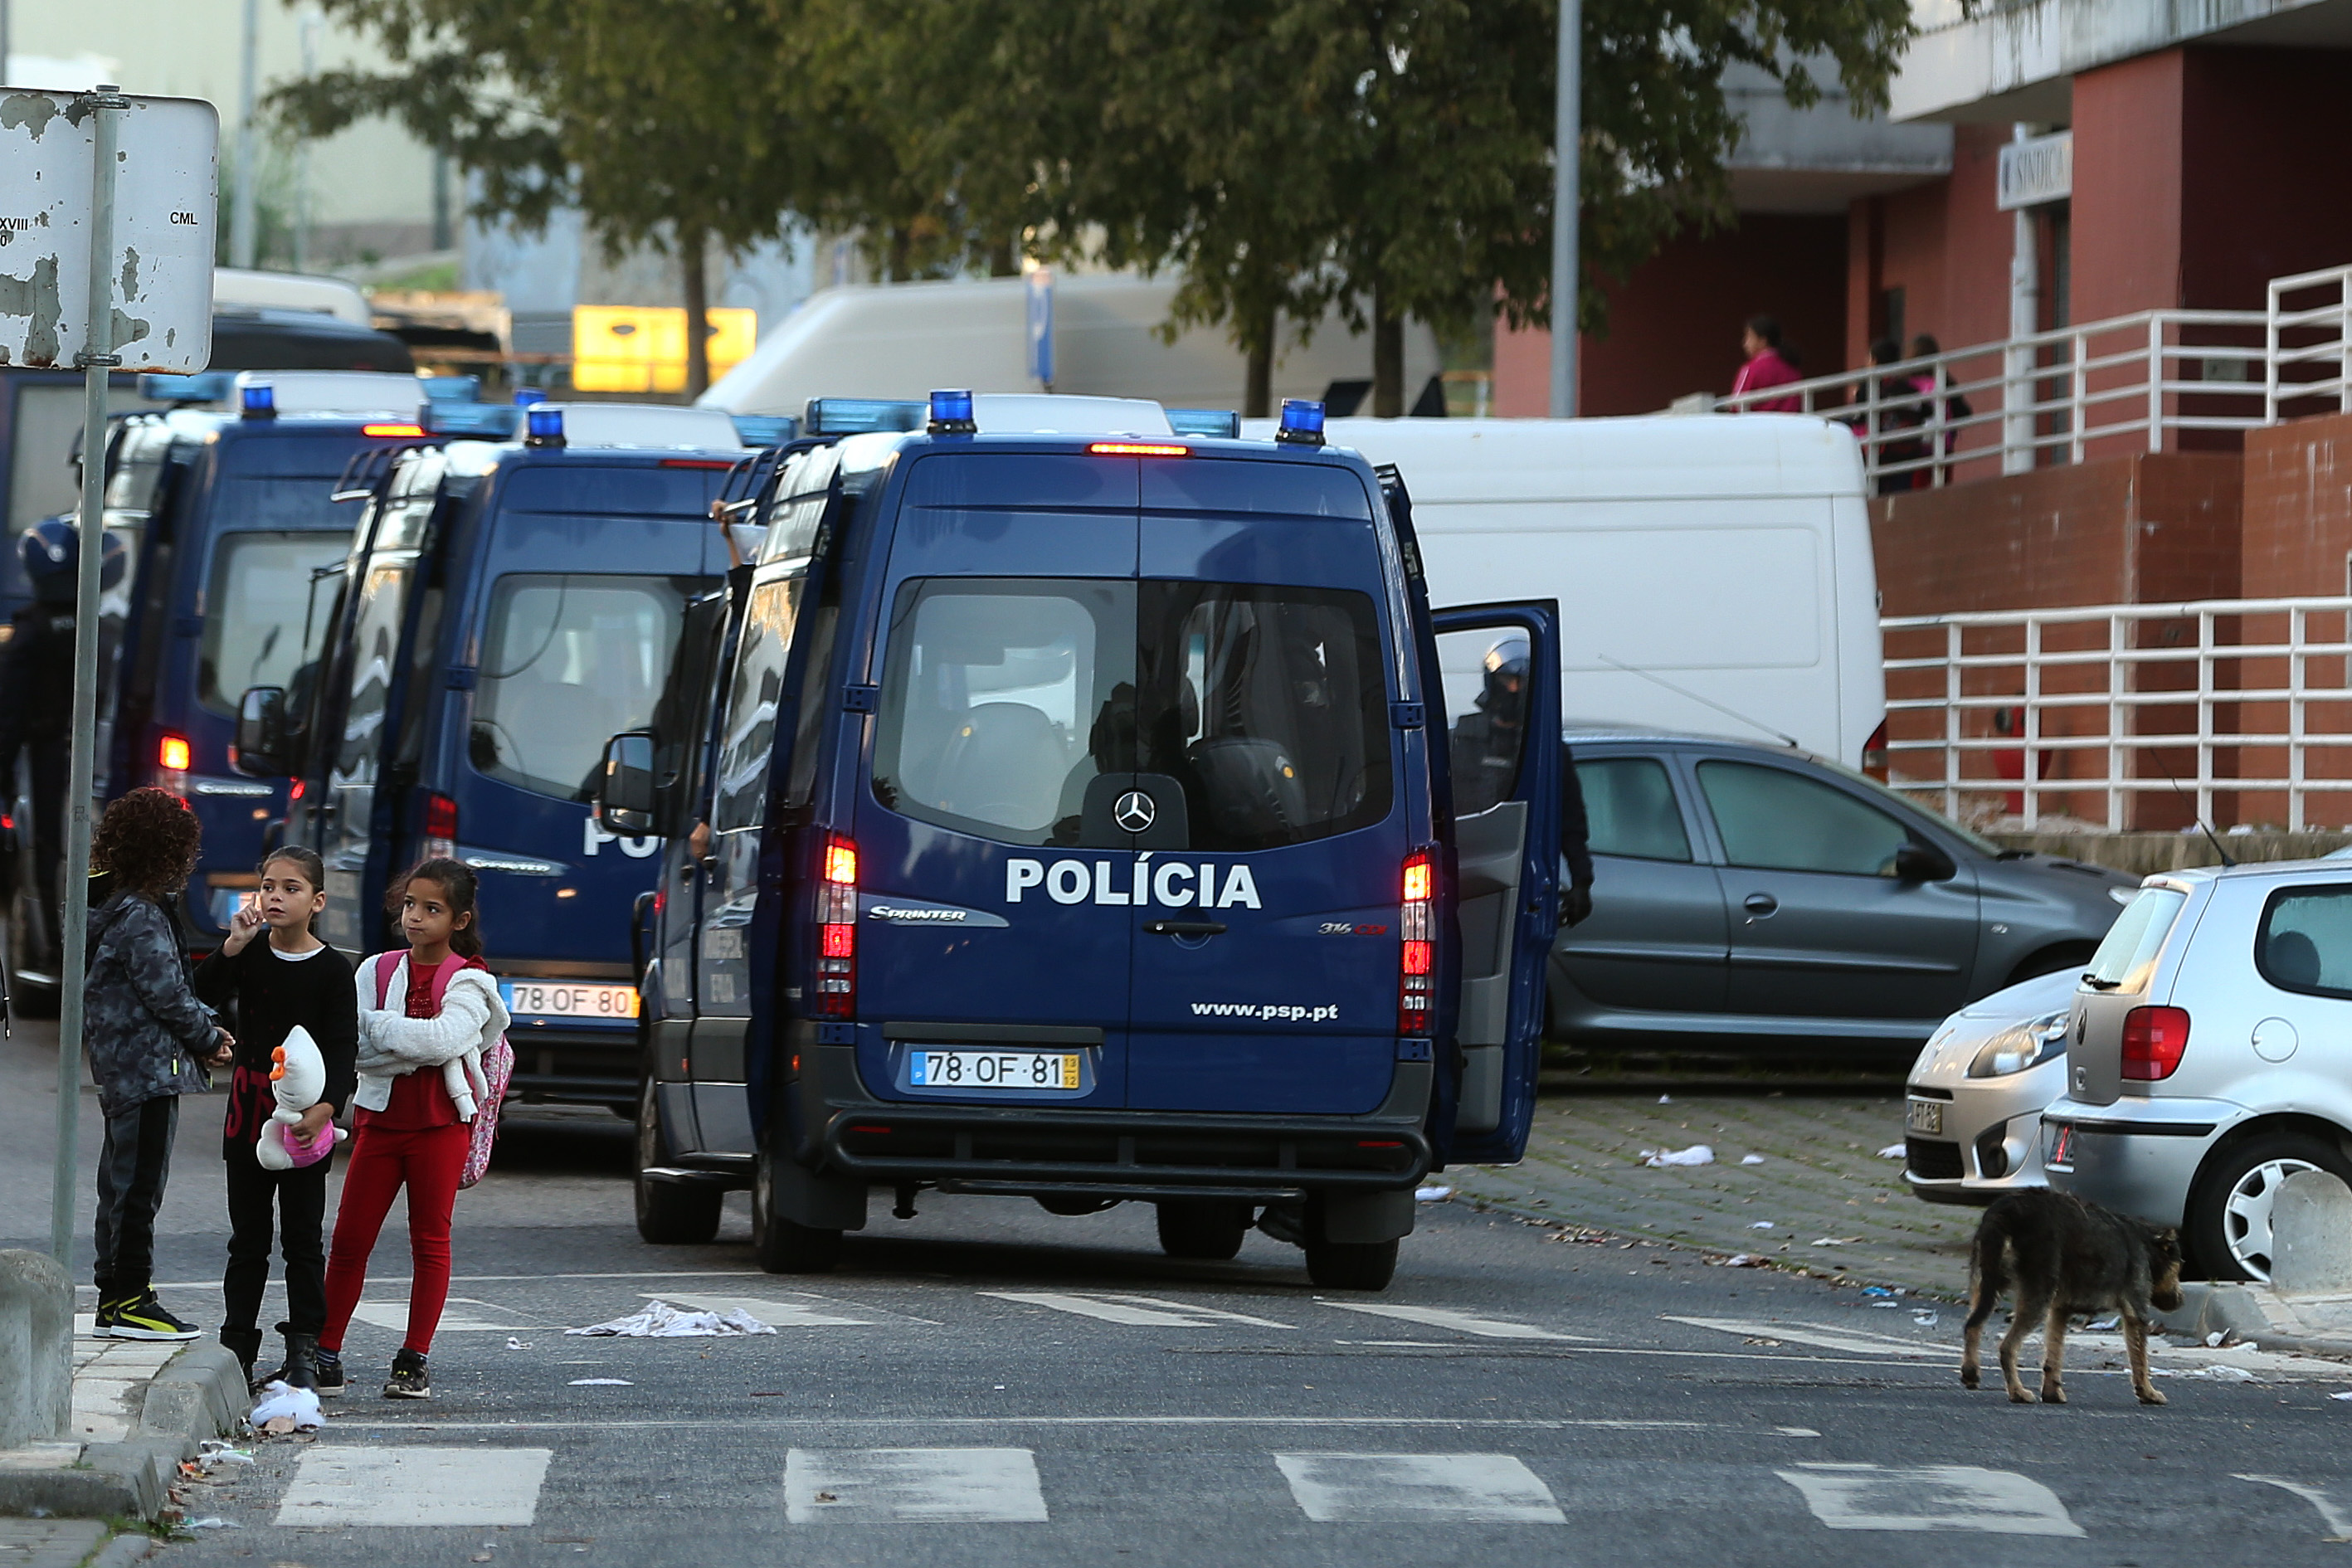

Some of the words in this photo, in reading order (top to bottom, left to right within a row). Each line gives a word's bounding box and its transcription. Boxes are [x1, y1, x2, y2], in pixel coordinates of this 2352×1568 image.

[170, 212, 198, 226] CML
[1006, 852, 1263, 909] POLÍCIA
[1317, 923, 1352, 935] 316
[1354, 923, 1389, 936] CDI
[1191, 1002, 1339, 1022] www.psp.pt
[1064, 1076, 1077, 1086] 12
